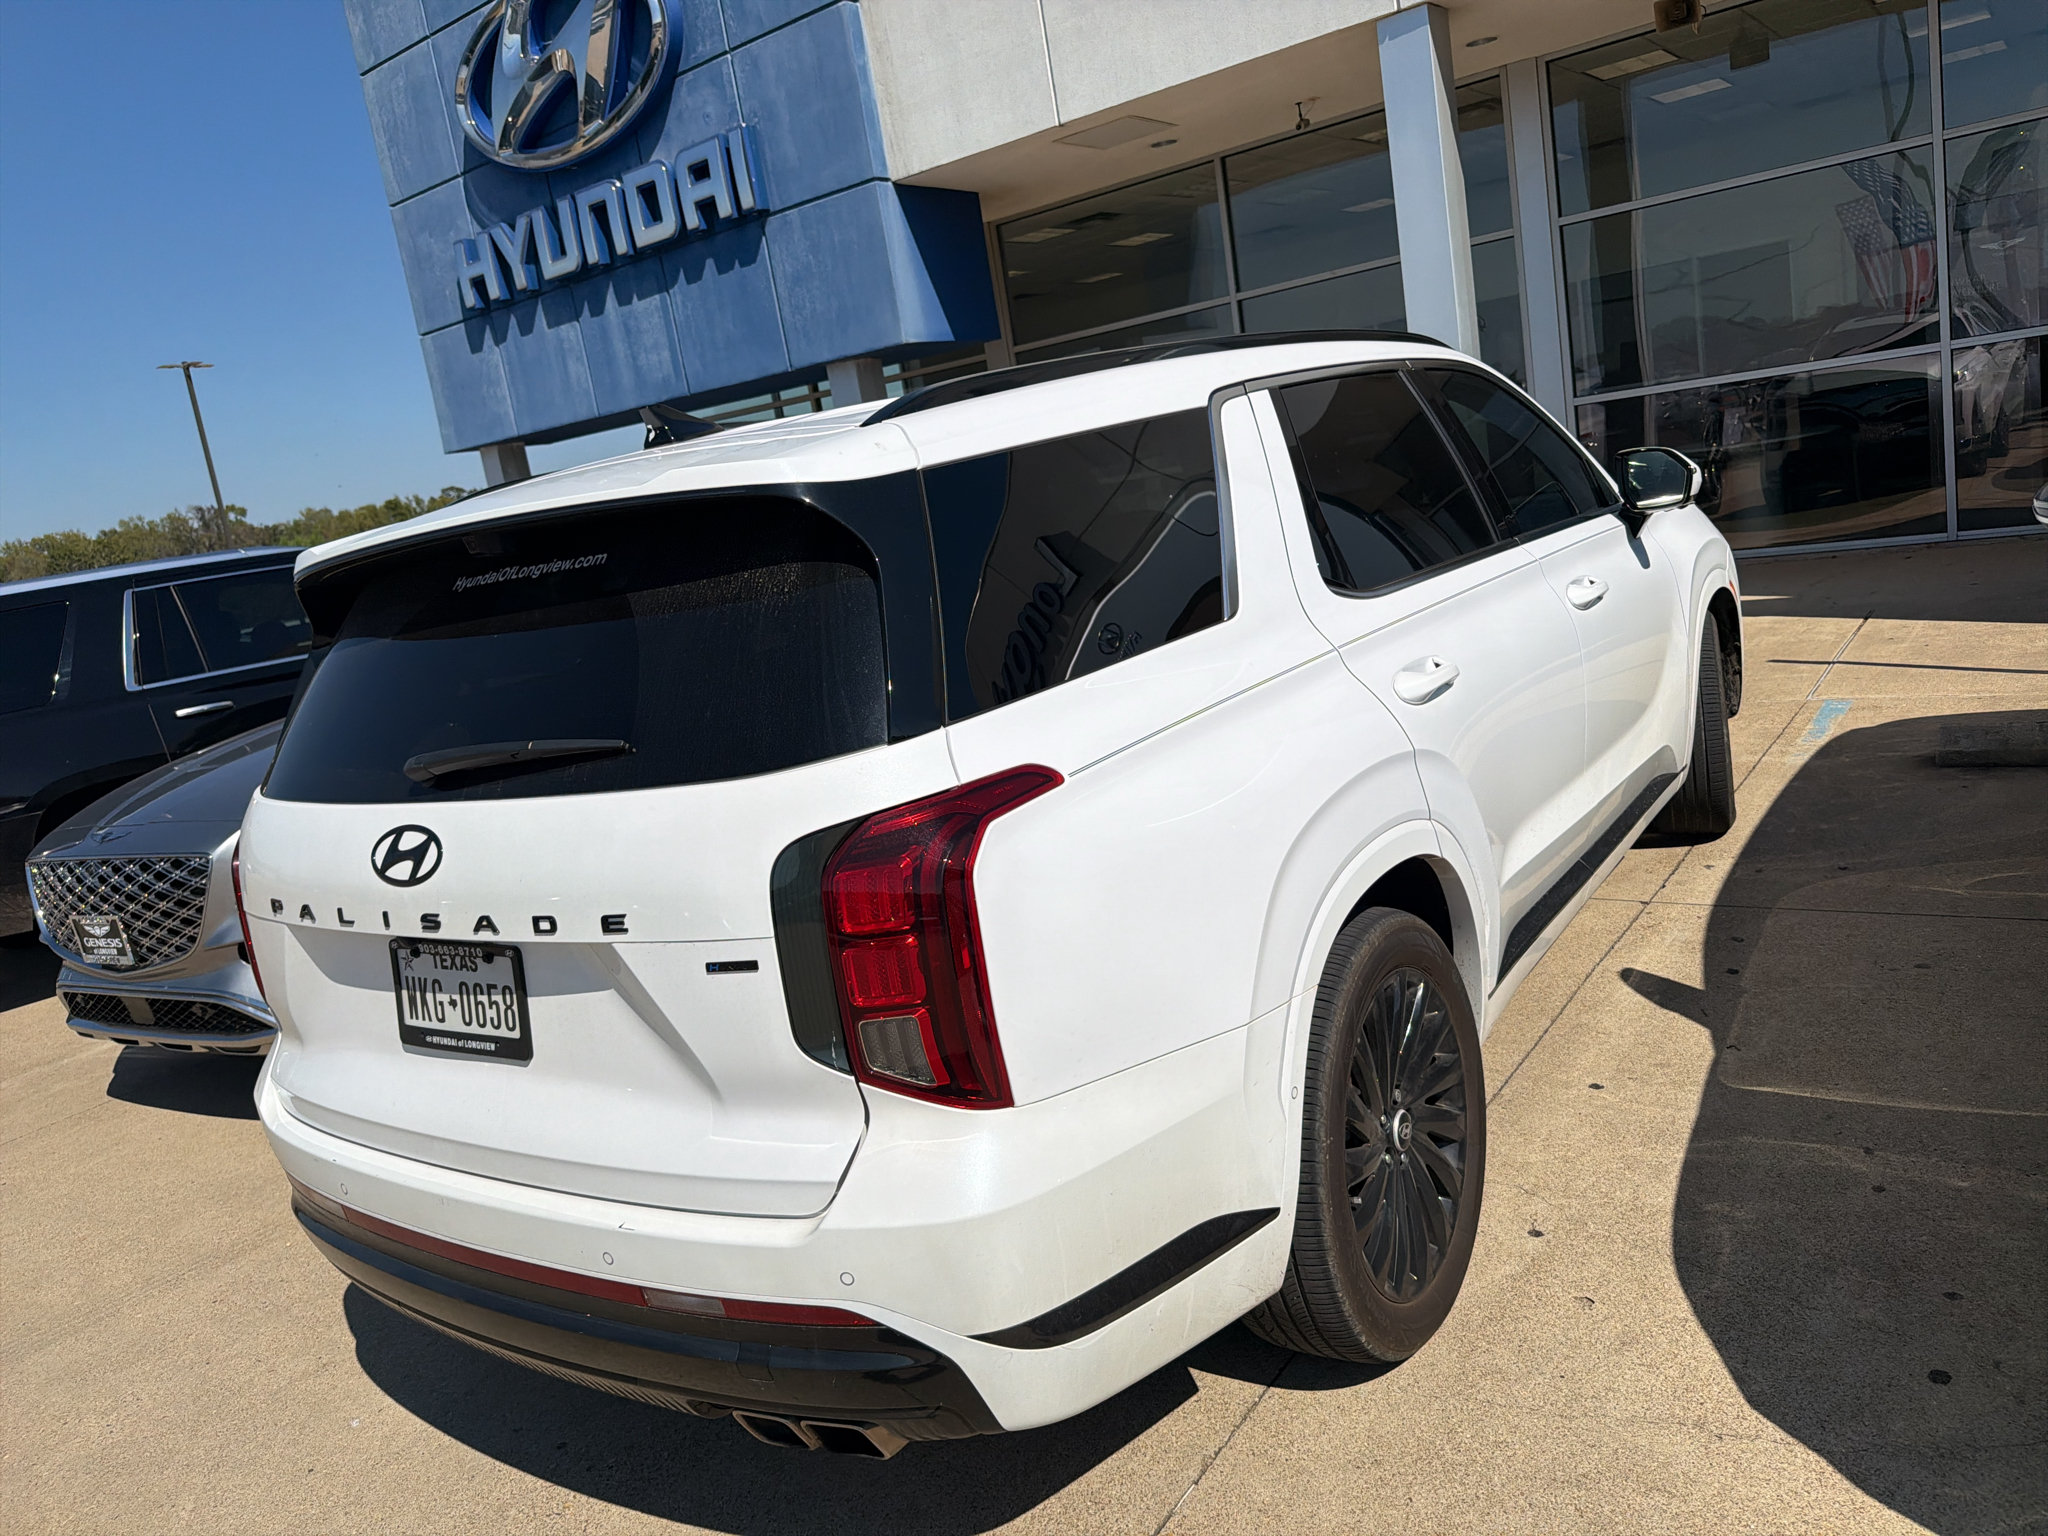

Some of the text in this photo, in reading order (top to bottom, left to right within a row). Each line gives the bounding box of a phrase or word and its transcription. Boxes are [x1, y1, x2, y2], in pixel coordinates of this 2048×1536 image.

[453, 125, 764, 310] HYUNDAI
[452, 552, 608, 593] HyundaiOfLongview.com
[270, 897, 630, 936] PALISADE
[83, 937, 123, 948] GENESIS
[432, 953, 479, 973] TEXAS
[432, 1035, 458, 1047] HYUNDAI
[464, 1039, 496, 1051] LONGVIEW
